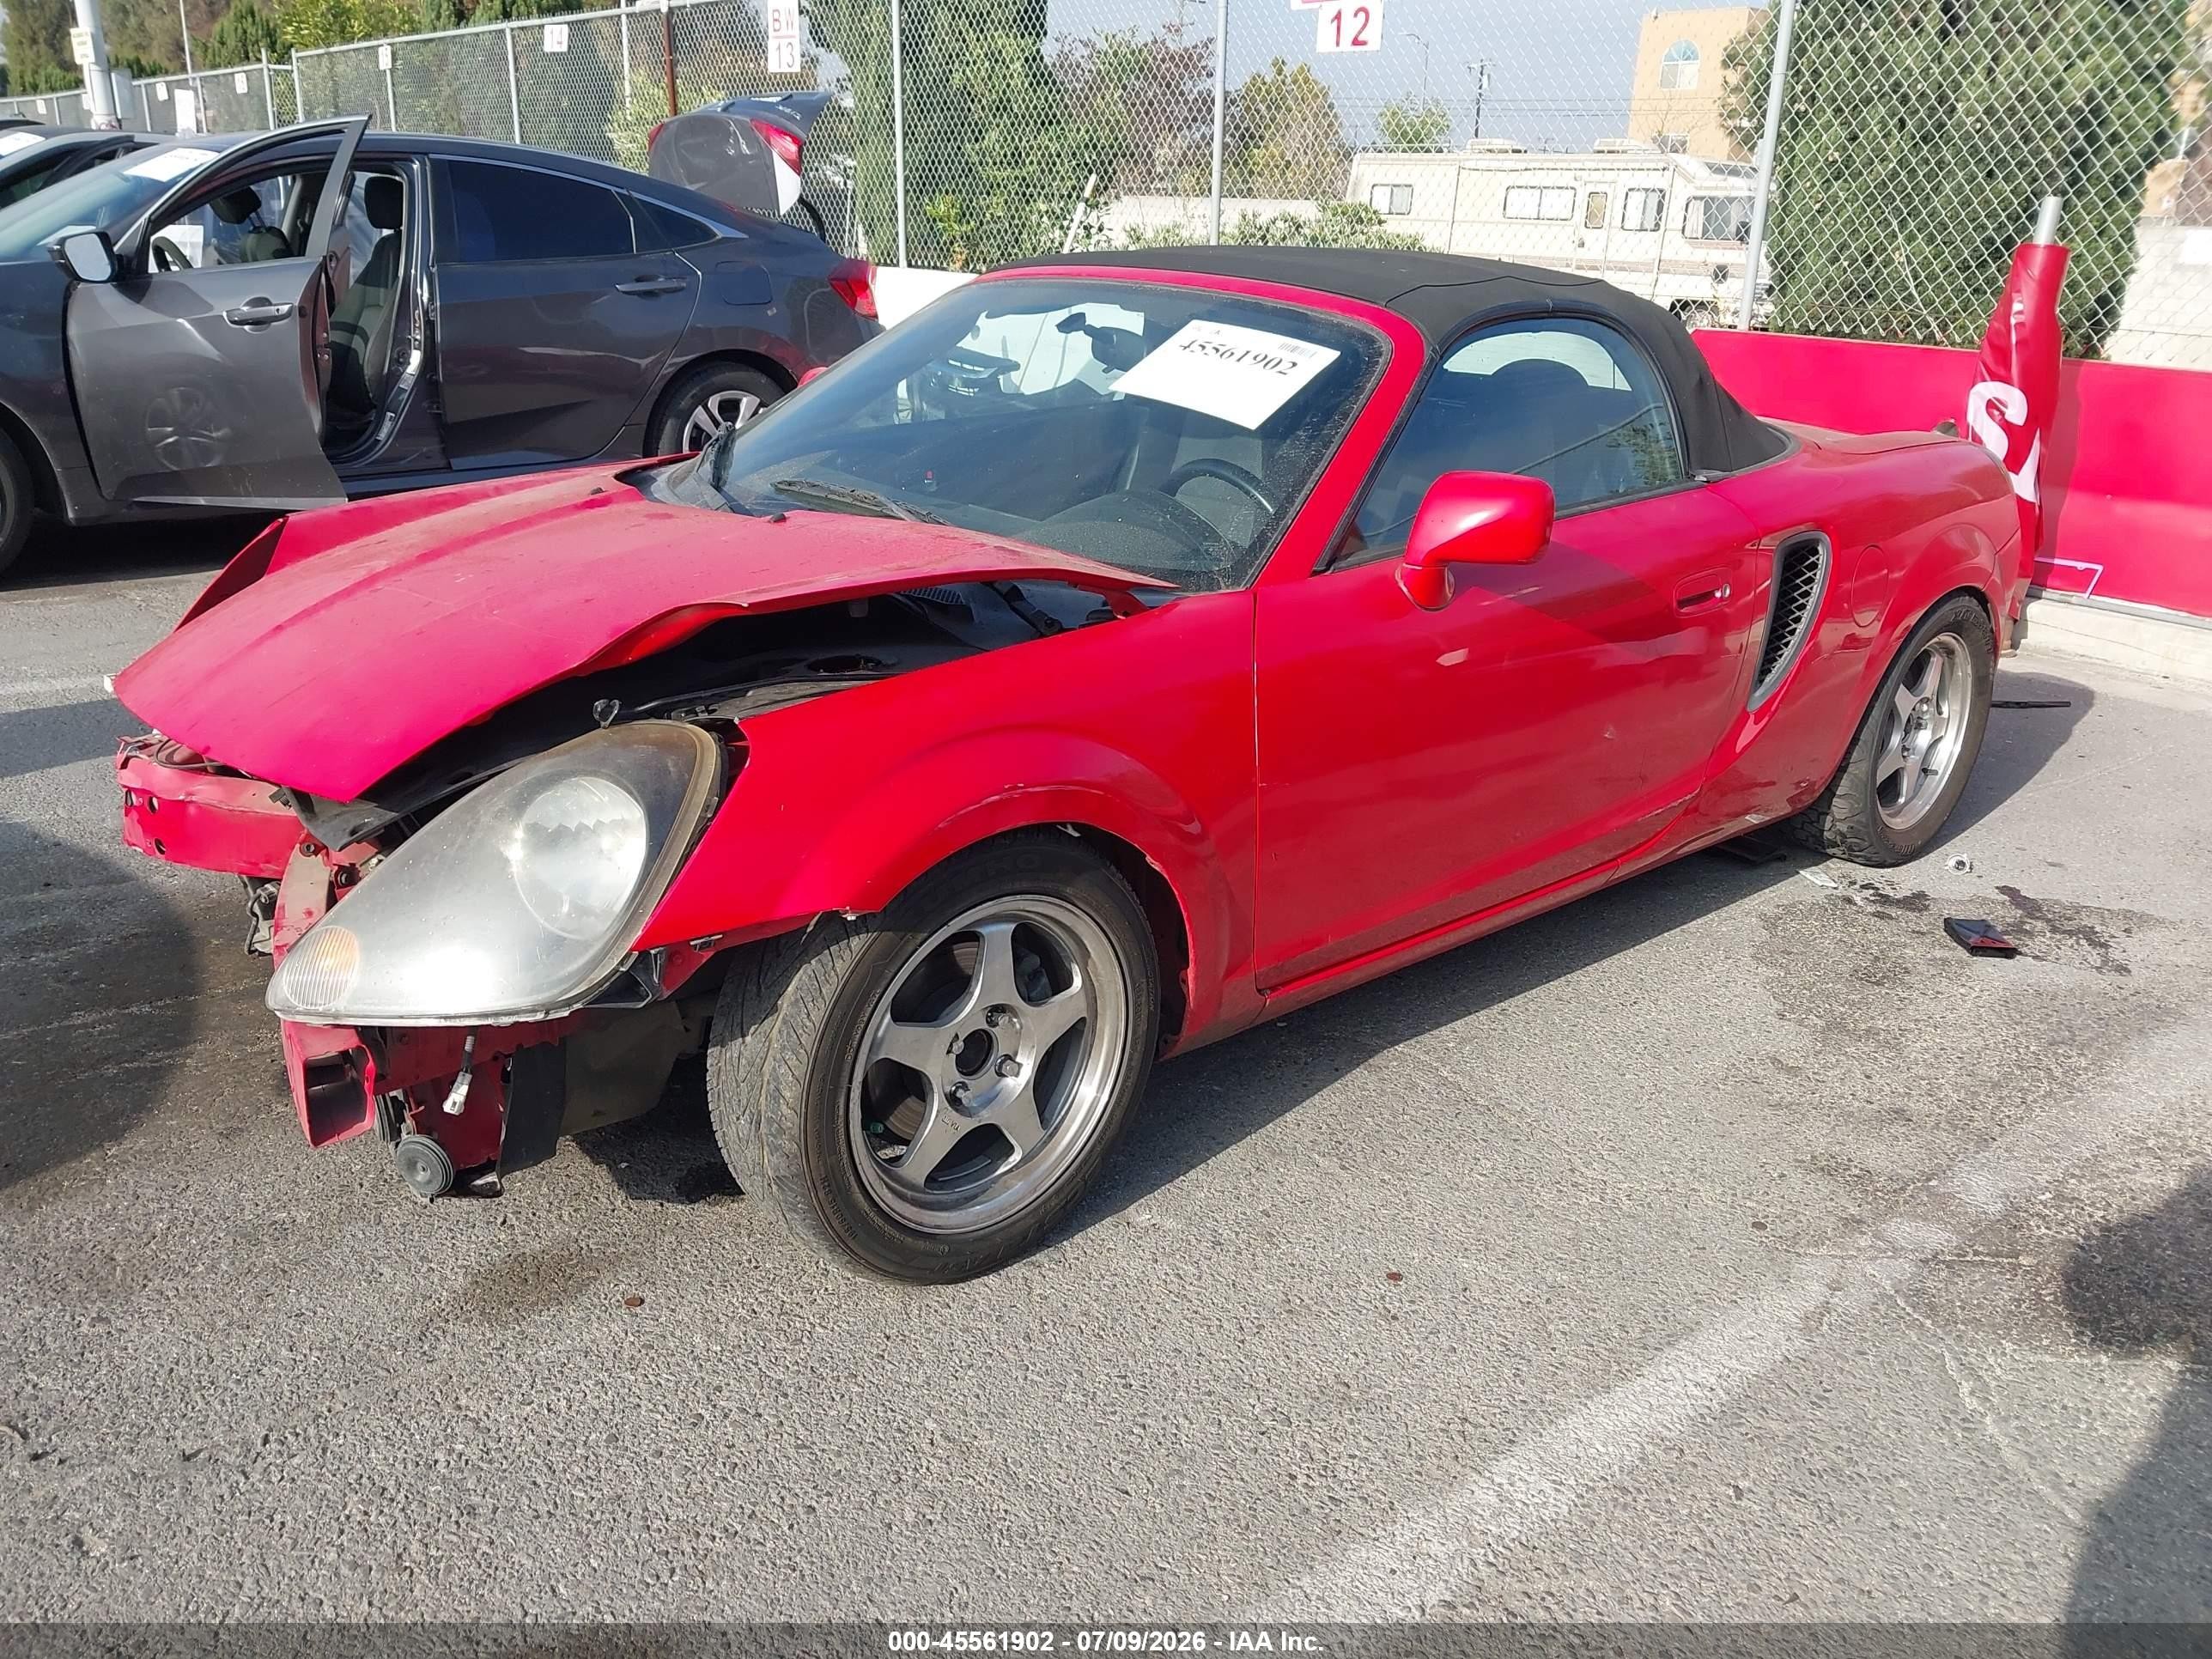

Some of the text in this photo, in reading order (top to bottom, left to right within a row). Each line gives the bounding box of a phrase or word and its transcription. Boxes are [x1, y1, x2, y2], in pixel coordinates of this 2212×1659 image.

[550, 27, 563, 49] 14
[1330, 7, 1370, 47] 12
[775, 40, 796, 70] 13
[1179, 339, 1298, 375] 45561902
